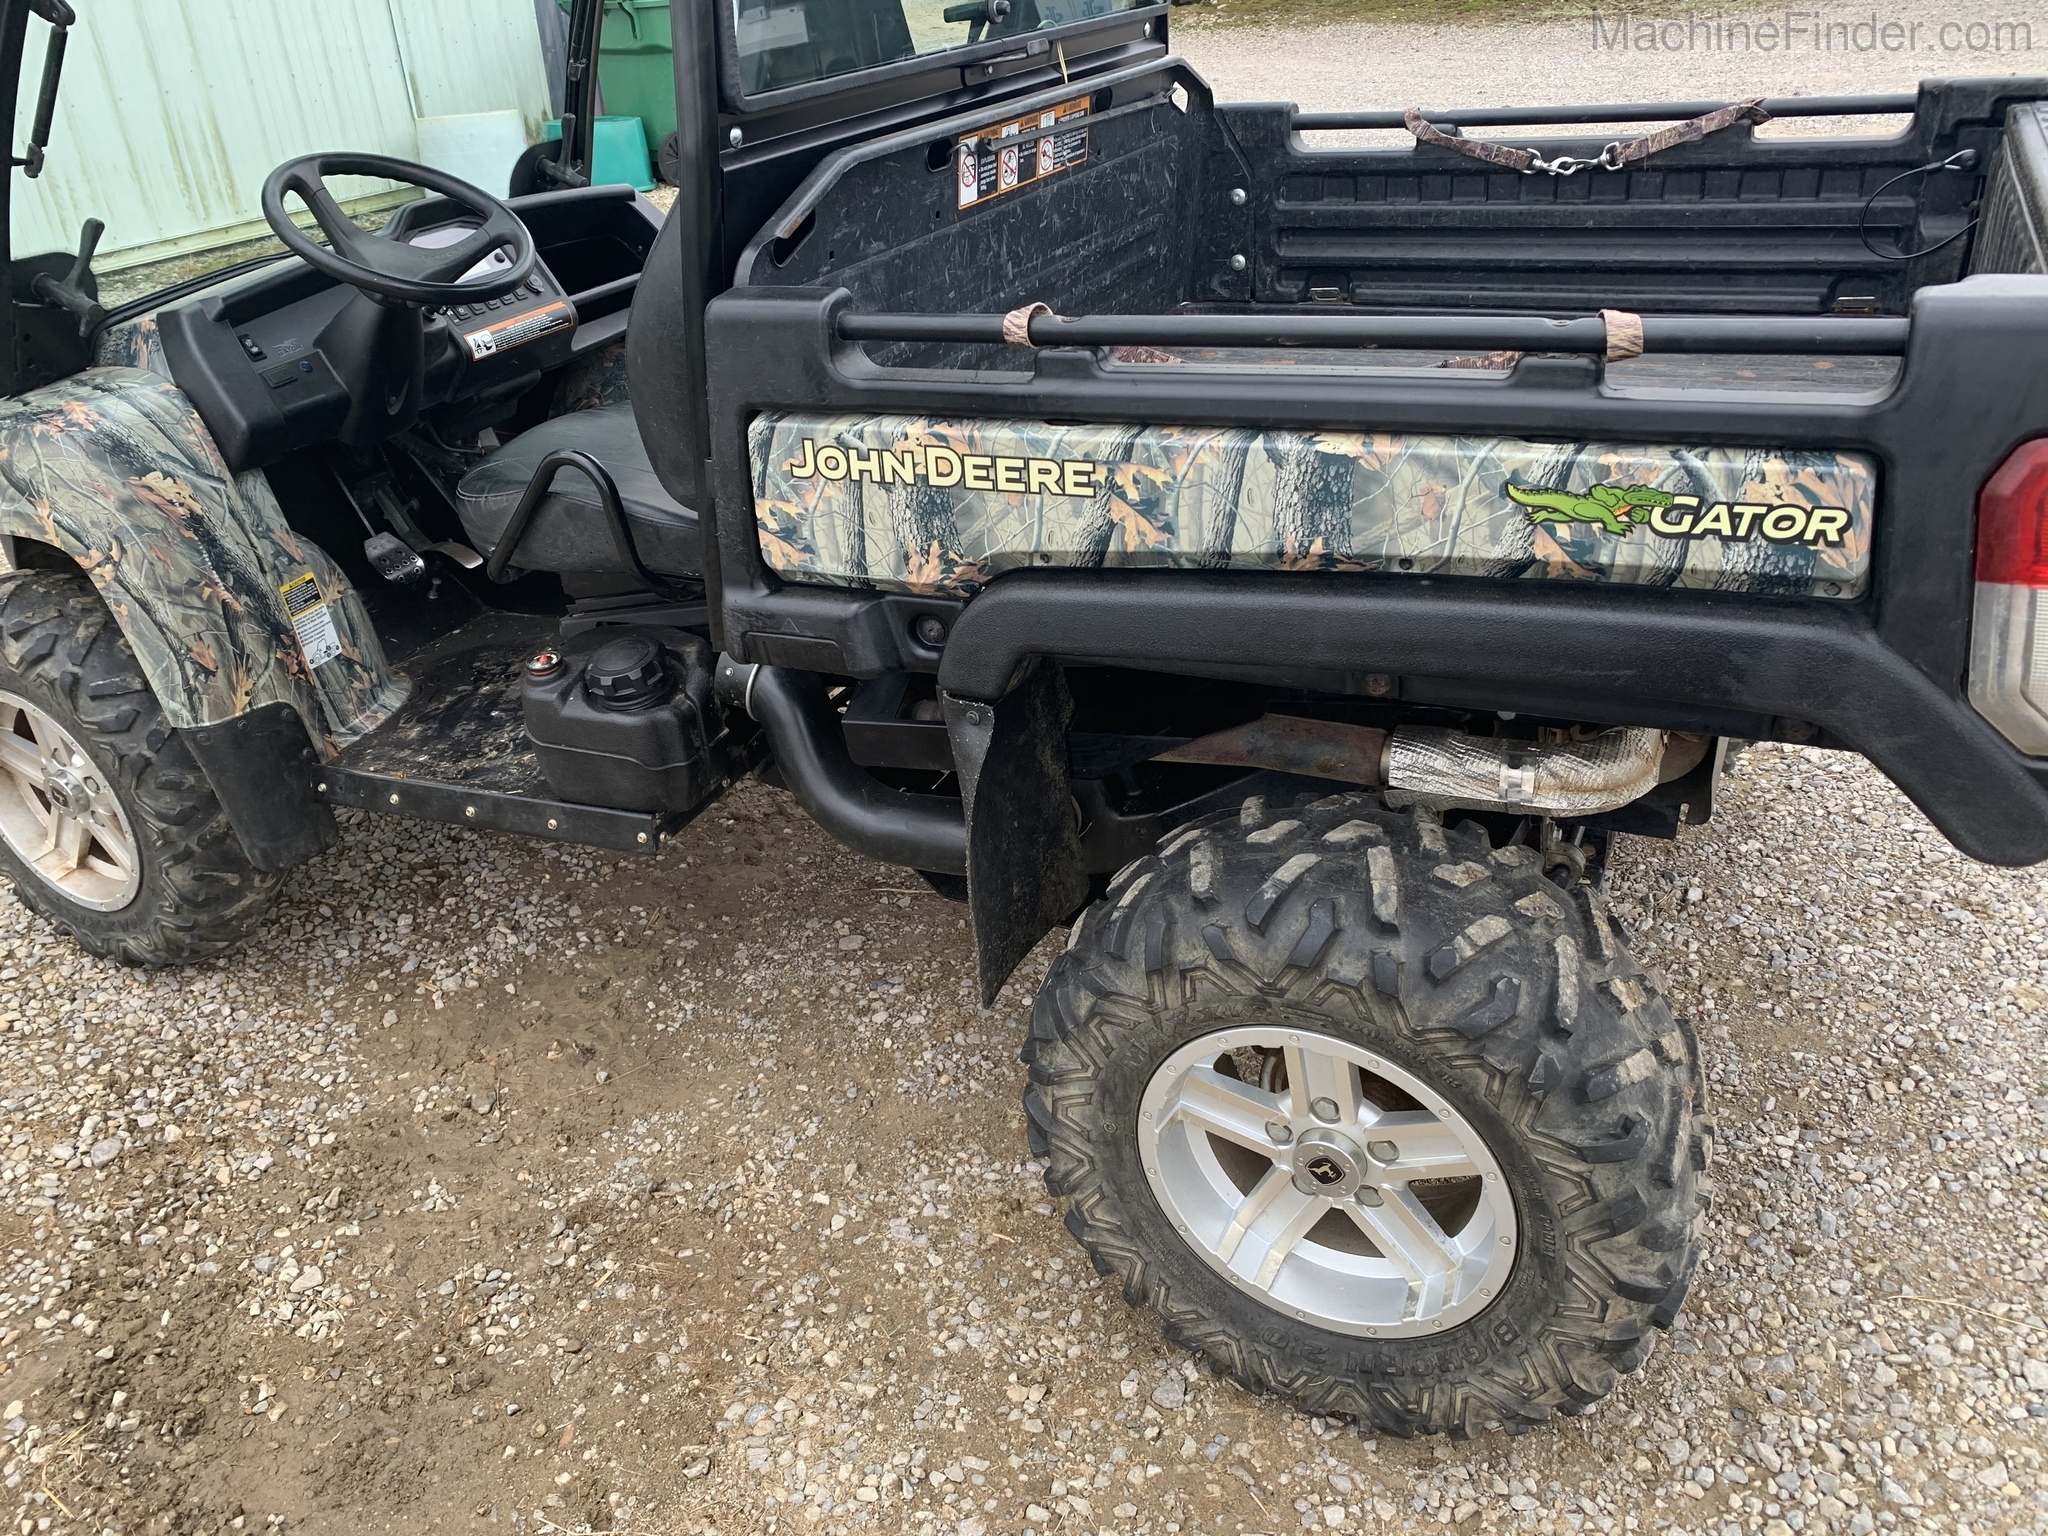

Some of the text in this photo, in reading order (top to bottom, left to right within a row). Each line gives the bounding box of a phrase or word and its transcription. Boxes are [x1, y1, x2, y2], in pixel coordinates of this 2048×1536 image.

[790, 437, 1096, 498] JOHN DEERE
[1650, 493, 1853, 546] GATOR
[1344, 1315, 1521, 1377] BIGHORN
